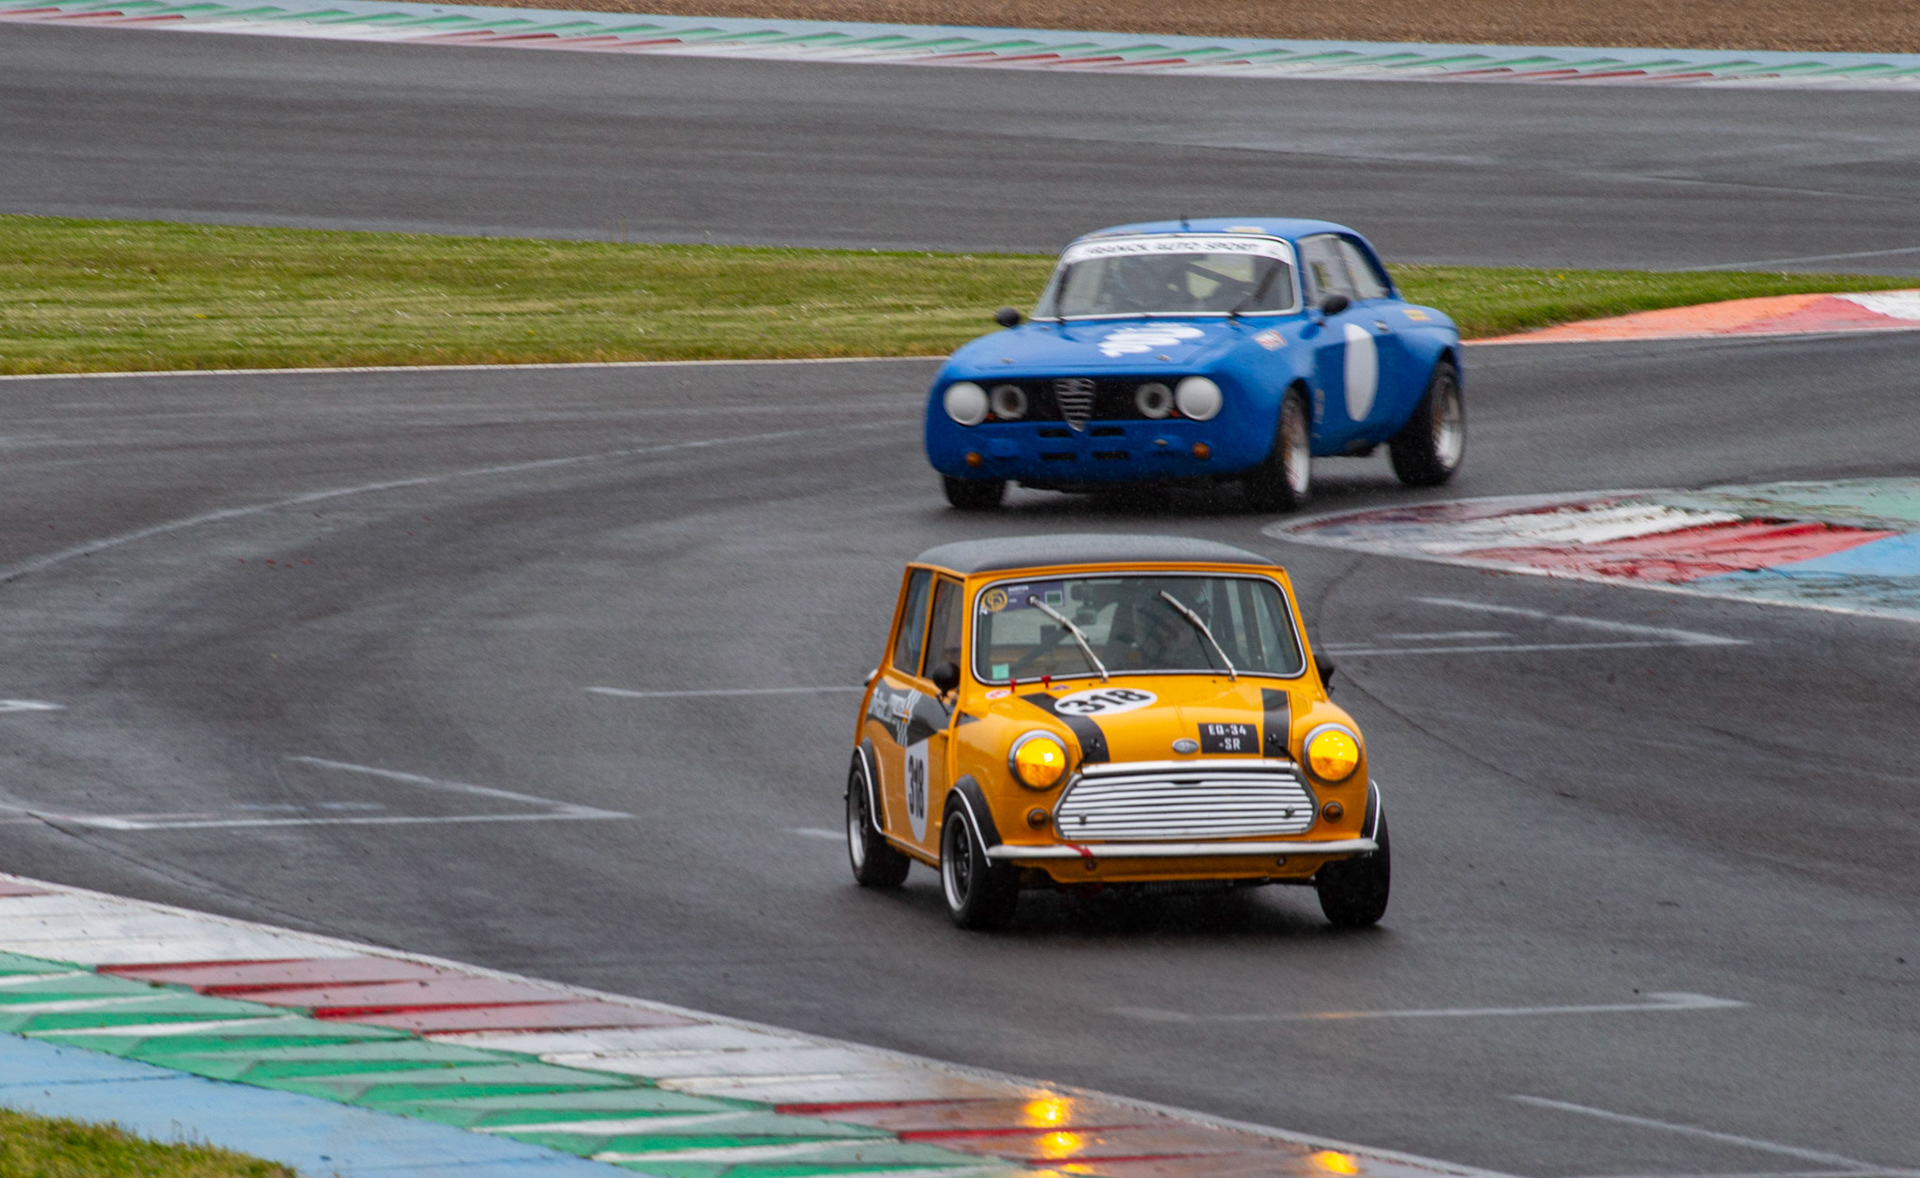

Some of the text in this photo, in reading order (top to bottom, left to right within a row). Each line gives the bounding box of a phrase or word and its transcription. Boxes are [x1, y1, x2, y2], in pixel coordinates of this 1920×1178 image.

[1157, 241, 1201, 251] AUTO
[1205, 240, 1260, 252] SPORT
[1058, 689, 1151, 713] 318
[908, 754, 924, 819] 318
